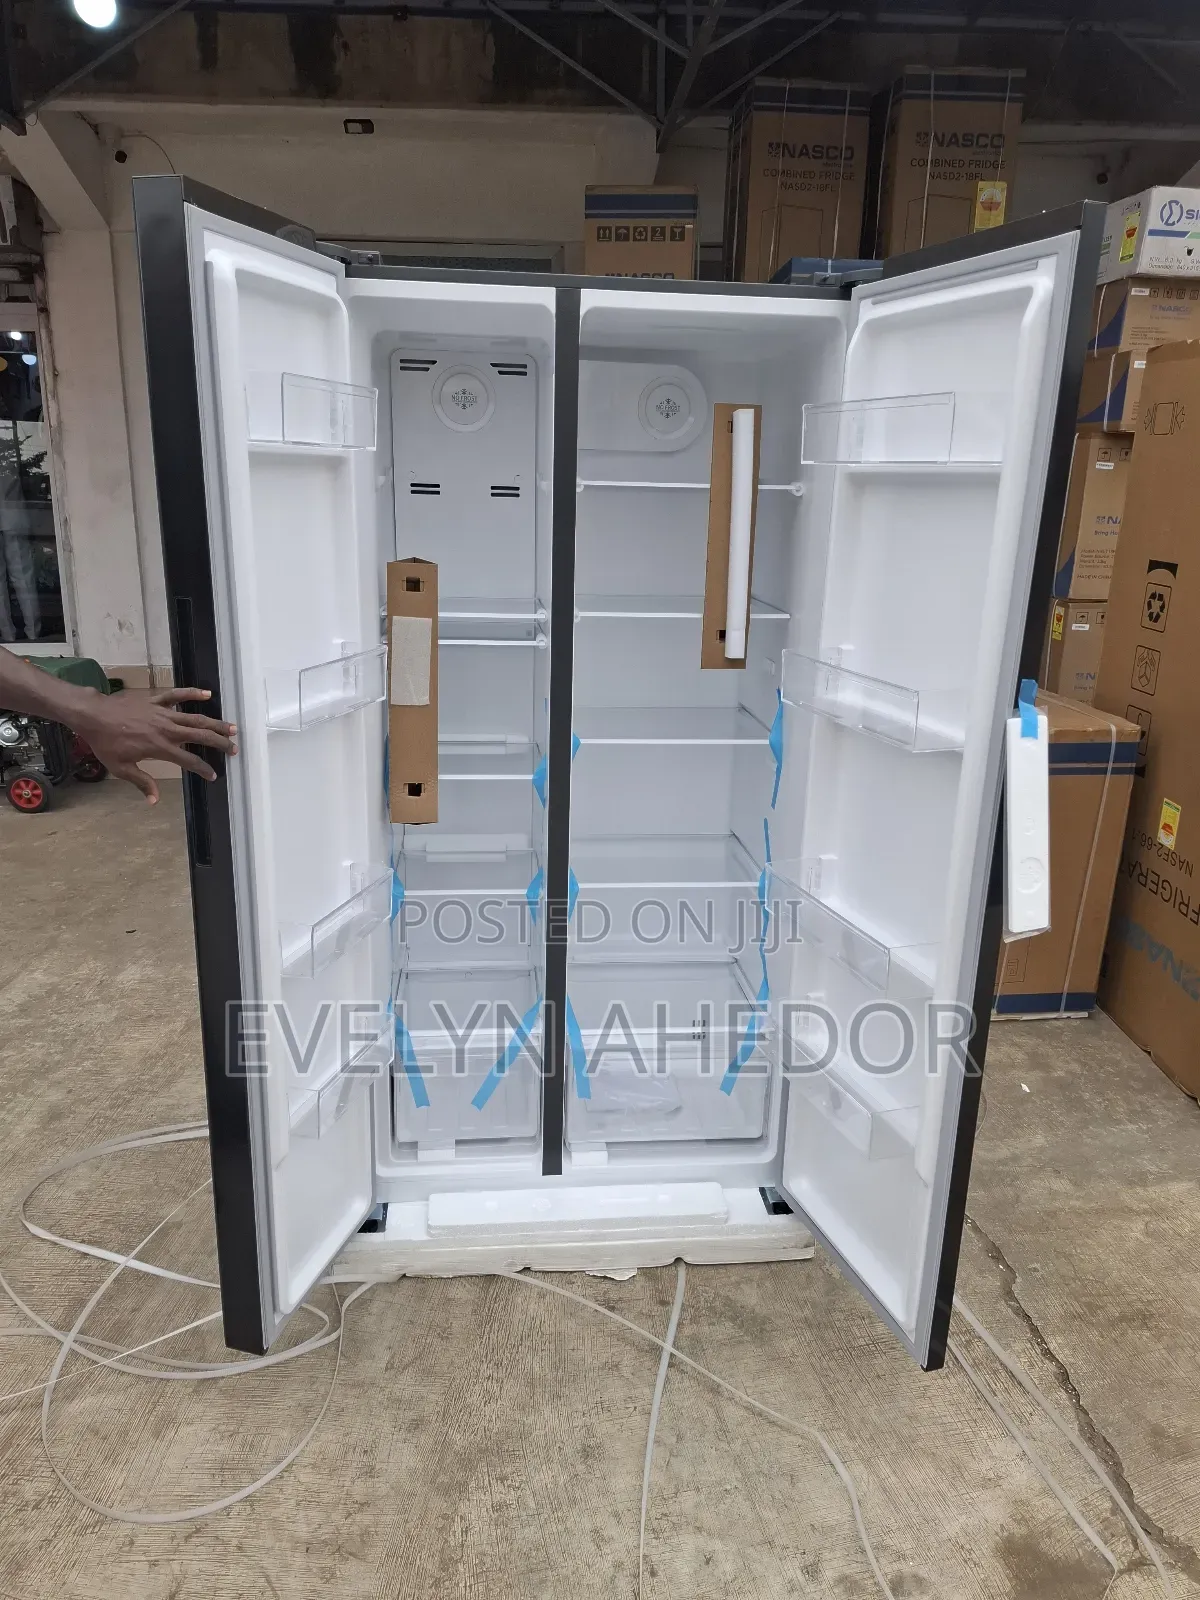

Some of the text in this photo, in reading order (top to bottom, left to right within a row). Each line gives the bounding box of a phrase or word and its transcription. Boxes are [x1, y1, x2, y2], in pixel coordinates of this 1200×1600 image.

[932, 131, 1005, 149] NASCO
[781, 142, 855, 160] NASCO
[910, 158, 1006, 170] COMBINED FRIDGE
[763, 168, 855, 181] COMBINED FRIDGE
[928, 171, 986, 181] NASD2-18FL
[780, 181, 837, 192] NASD2-18FL
[1185, 208, 1200, 221] SI
